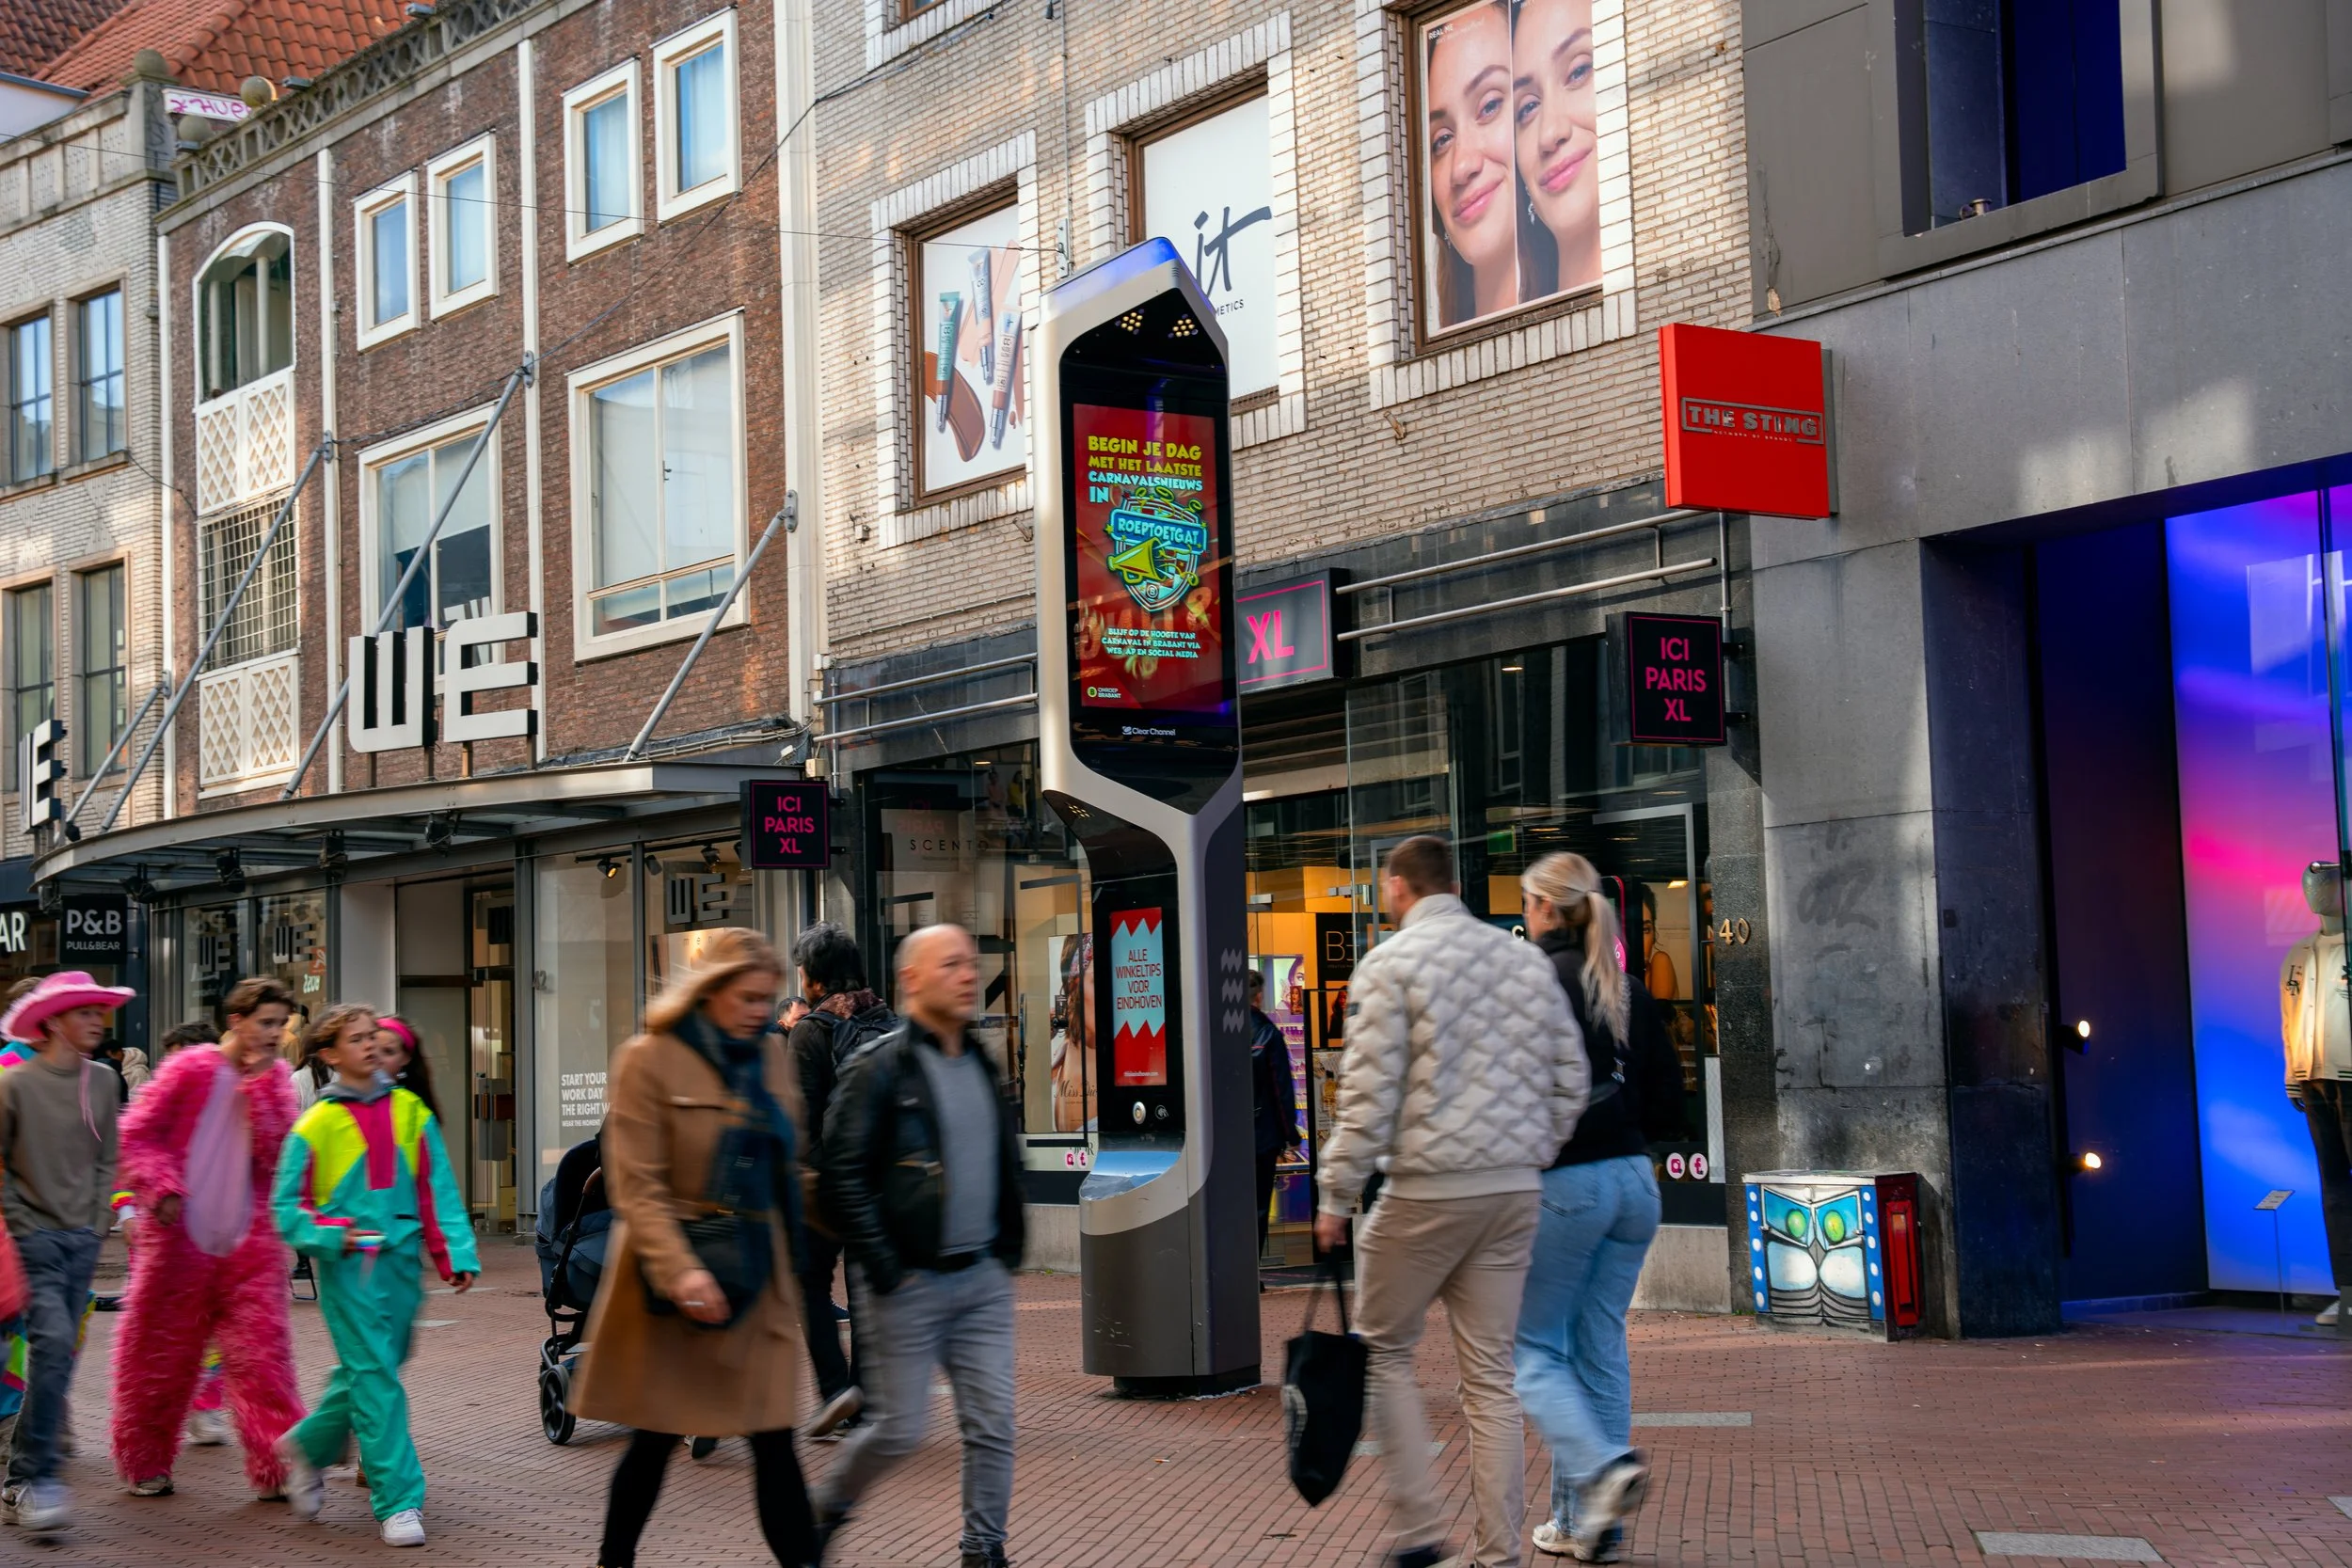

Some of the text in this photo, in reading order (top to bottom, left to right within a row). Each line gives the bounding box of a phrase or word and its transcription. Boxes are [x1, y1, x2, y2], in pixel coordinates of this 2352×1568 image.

[1689, 406, 1818, 436] THE STING
[1088, 436, 1202, 460] BEGIN JE DAG
[1089, 455, 1202, 477] MET HET LAATSTE
[1089, 470, 1203, 491] CARNAVALSNIEUWS
[1089, 486, 1109, 503] IN
[1118, 517, 1200, 546] ROEPTOETGAT
[1102, 637, 1142, 646] CARNAVAL
[1153, 640, 1186, 648] BRABANT
[1151, 630, 1179, 639] HOOGTE
[1247, 610, 1295, 664] XL
[1148, 649, 1174, 657] SOCIAL
[1661, 637, 1689, 660] ICI
[348, 611, 538, 752] WE
[1645, 667, 1707, 692] PARIS
[1663, 698, 1692, 721] XL
[777, 796, 802, 812] ICI
[764, 816, 815, 833] PARIS
[779, 837, 803, 854] XL
[667, 873, 728, 924] WE
[67, 909, 122, 935] P&B
[1718, 917, 1751, 945] 40
[66, 941, 120, 952] PULL&BEAR
[1128, 948, 1148, 962] ALLE
[1115, 963, 1162, 979] WINKELTIPS
[1127, 980, 1150, 994] VOOR
[1117, 994, 1163, 1010] EINDHOVEN
[561, 1072, 607, 1085] START YOUR
[562, 1087, 603, 1101] WORK DAY
[562, 1103, 576, 1116] THE
[577, 1102, 600, 1115] RIGHT
